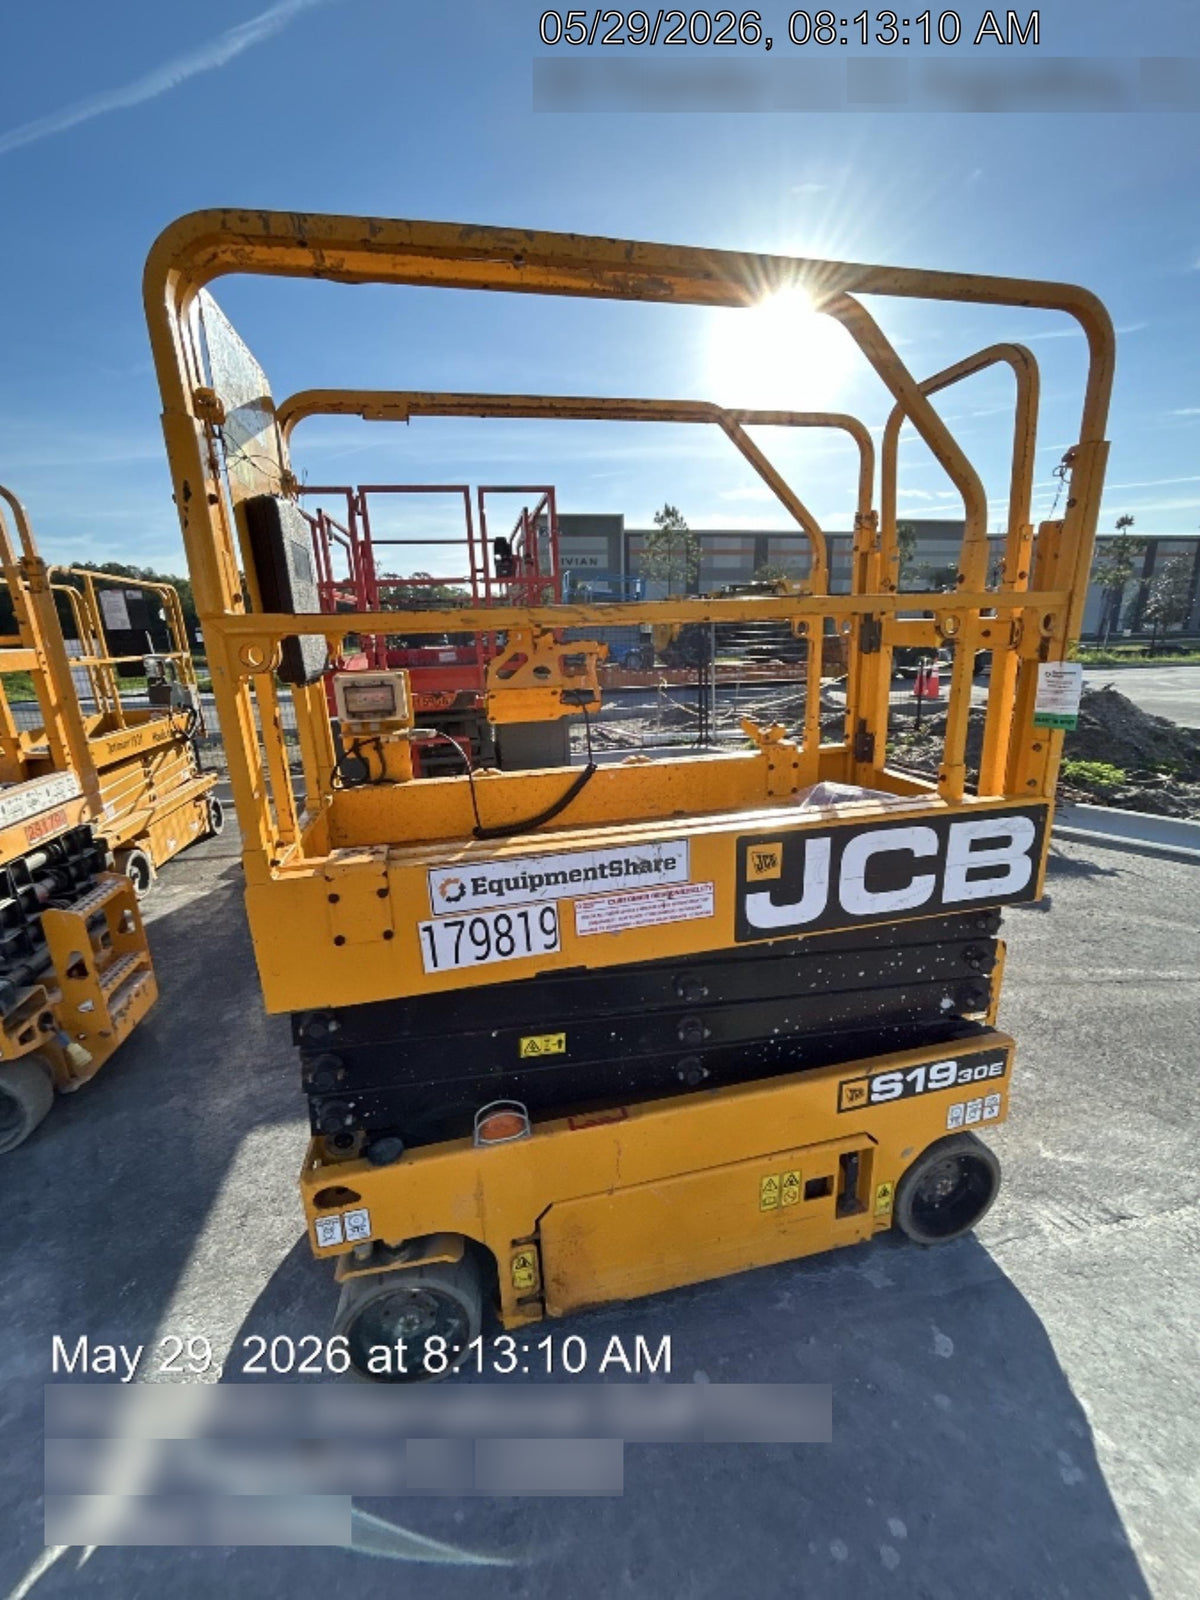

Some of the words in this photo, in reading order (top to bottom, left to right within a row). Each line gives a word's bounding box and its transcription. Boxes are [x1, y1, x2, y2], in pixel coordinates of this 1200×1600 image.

[560, 557, 598, 566] IVIAN
[470, 855, 677, 897] EquipmentShare
[746, 815, 1035, 929] JCB
[421, 905, 559, 968] 179819
[870, 1060, 958, 1102] S19
[957, 1062, 1004, 1084] 30E
